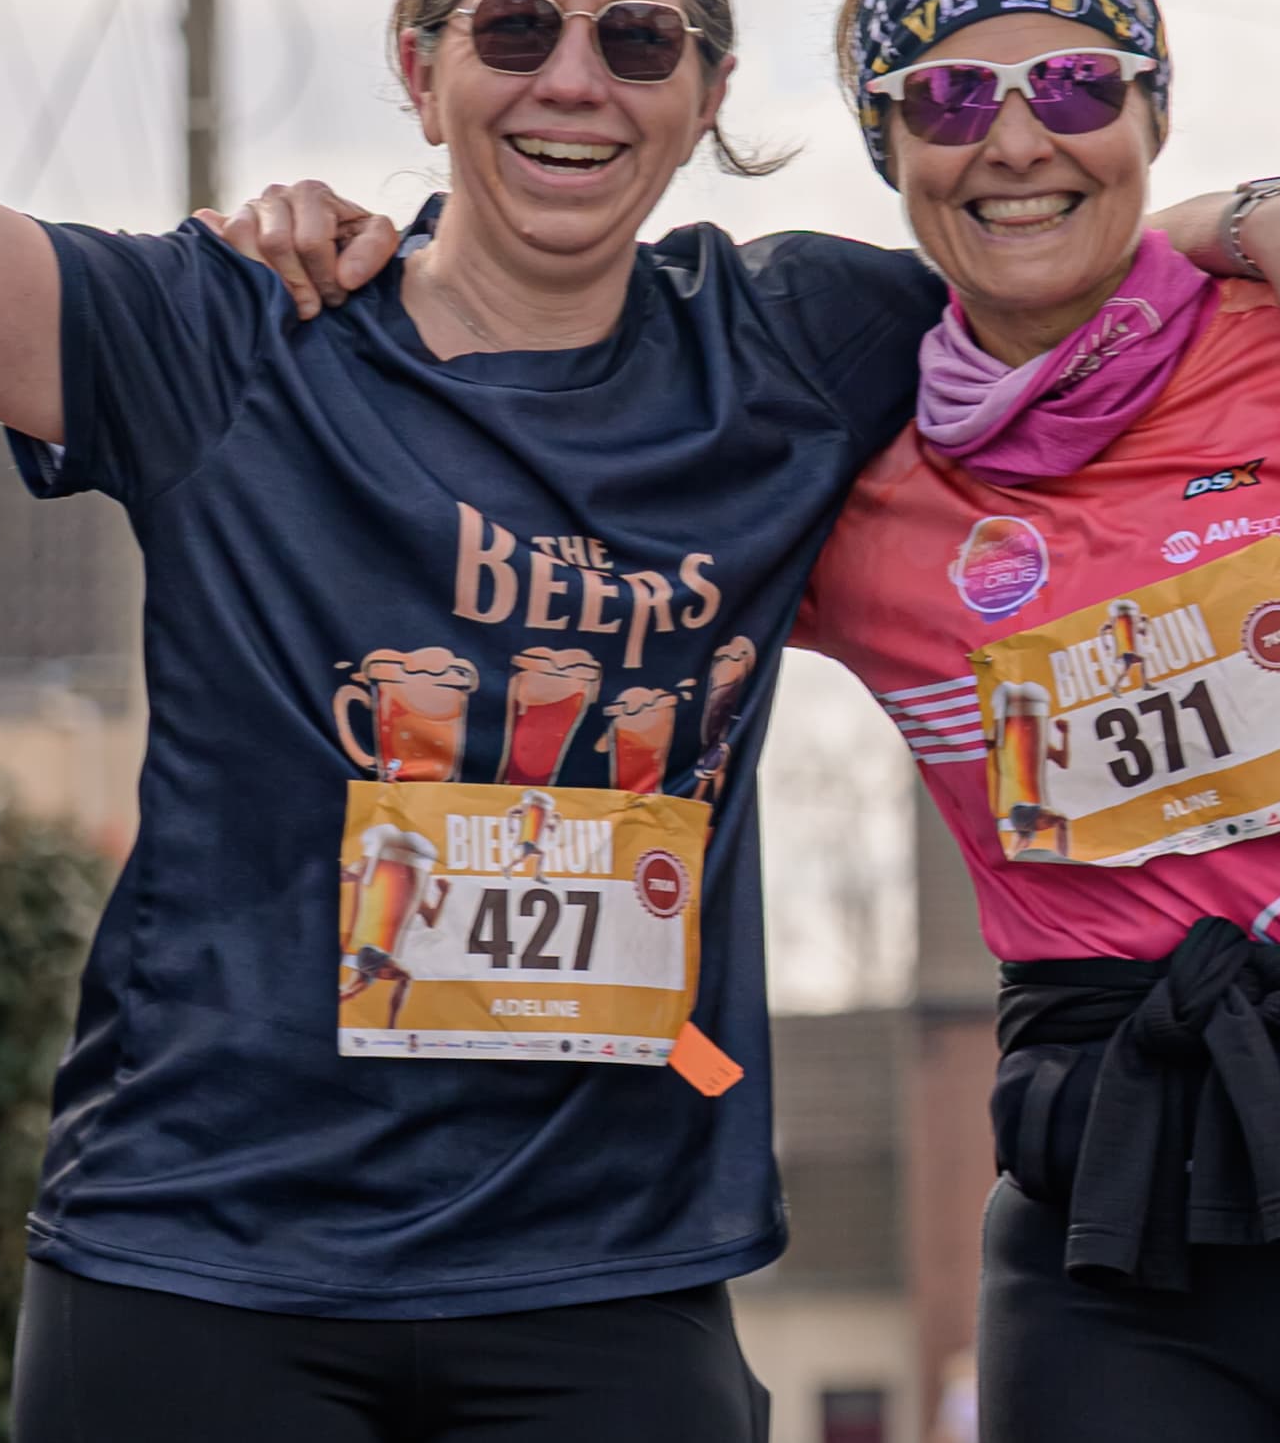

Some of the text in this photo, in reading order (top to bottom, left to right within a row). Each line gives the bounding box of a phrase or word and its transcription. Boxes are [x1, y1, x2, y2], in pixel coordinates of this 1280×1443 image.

[1184, 458, 1266, 499] DSX
[531, 536, 614, 570] THE
[451, 501, 721, 669] BEERS
[1143, 603, 1217, 679] RUN
[1094, 679, 1232, 788] 371
[1163, 789, 1222, 821] ALINE
[542, 819, 613, 874] RUN
[468, 888, 601, 971] 427
[490, 998, 581, 1018] ADELINE
